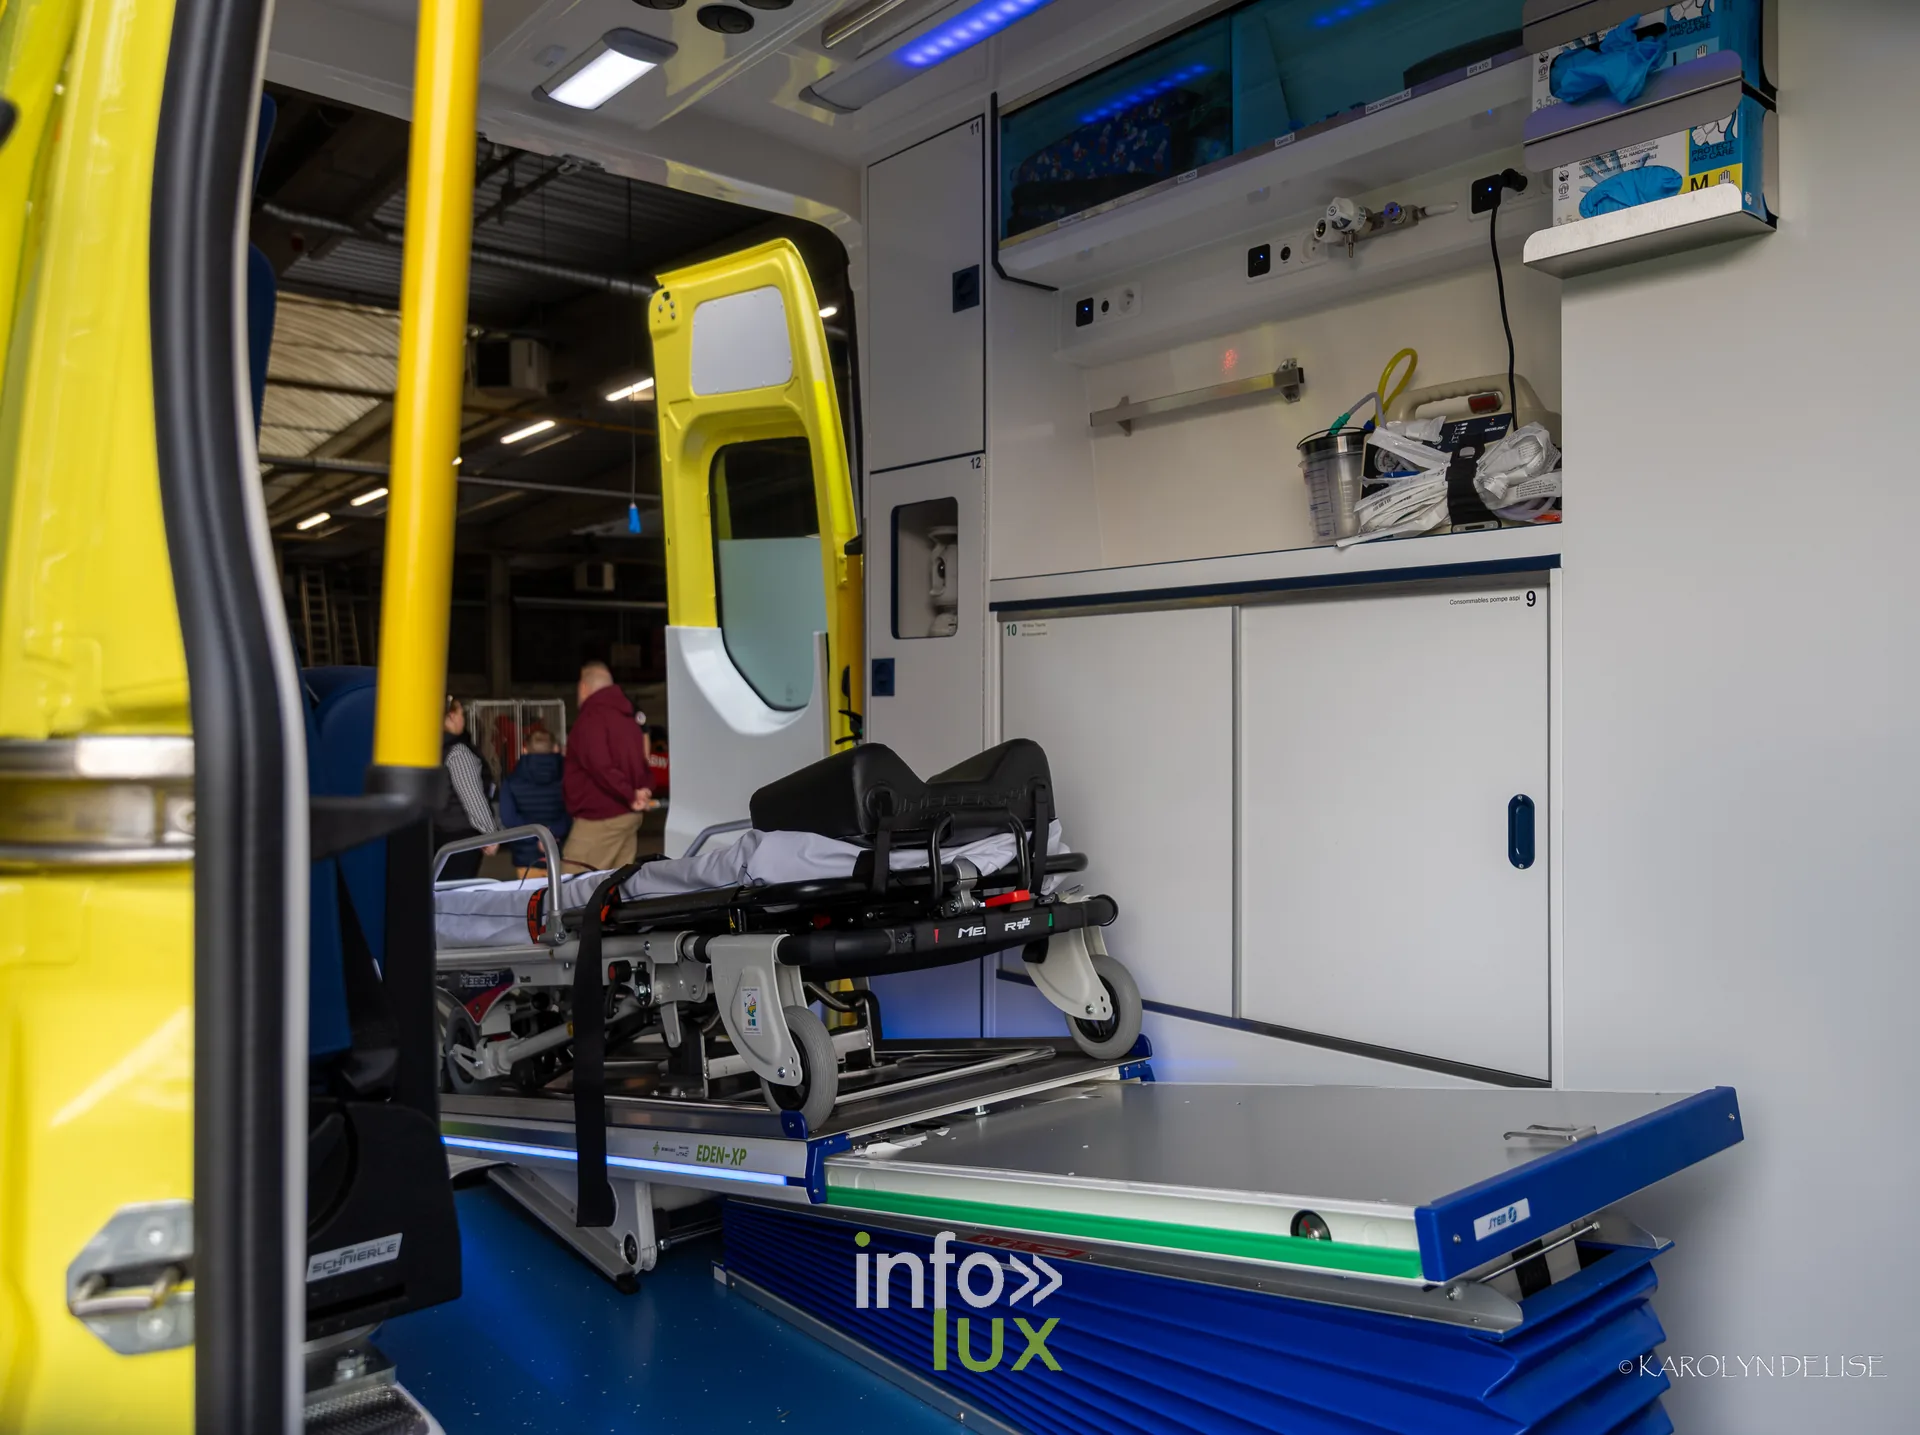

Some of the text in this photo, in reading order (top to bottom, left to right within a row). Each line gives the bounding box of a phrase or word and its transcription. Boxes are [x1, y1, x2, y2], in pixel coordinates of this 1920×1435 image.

[1669, 14, 1711, 33] PROTECT
[1669, 22, 1711, 38] AND CARE
[970, 121, 980, 135] 11
[1691, 141, 1733, 157] PROTECT
[1692, 148, 1735, 163] AND CARE
[1690, 174, 1709, 192] M
[970, 456, 981, 470] 12
[1449, 594, 1521, 606] Consommables pompe aspi
[1525, 590, 1537, 607] 9
[1006, 623, 1018, 637] 10
[696, 1144, 747, 1166] EDEN-XP
[312, 1243, 397, 1274] SCHNIERLE
